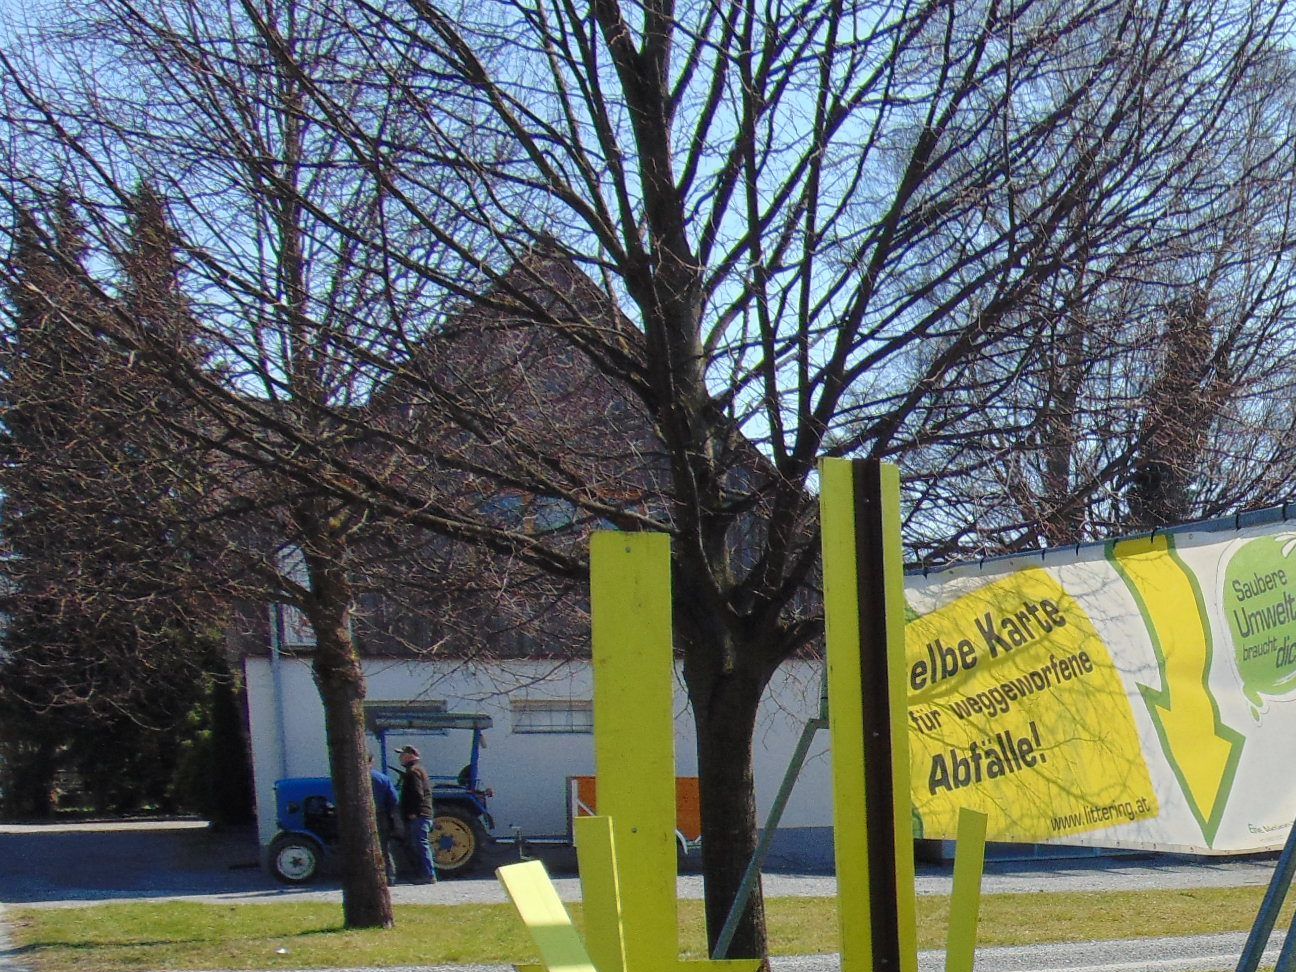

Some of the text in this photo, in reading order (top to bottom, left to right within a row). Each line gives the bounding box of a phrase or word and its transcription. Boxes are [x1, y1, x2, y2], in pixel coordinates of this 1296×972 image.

[1232, 569, 1288, 602] Saubere
[910, 598, 1067, 691] elbe Karte
[1242, 636, 1278, 661] braucht
[907, 649, 1094, 735] für weggeworfene
[928, 720, 1048, 796] Abfälle!
[1050, 796, 1151, 832] www.littering.at
